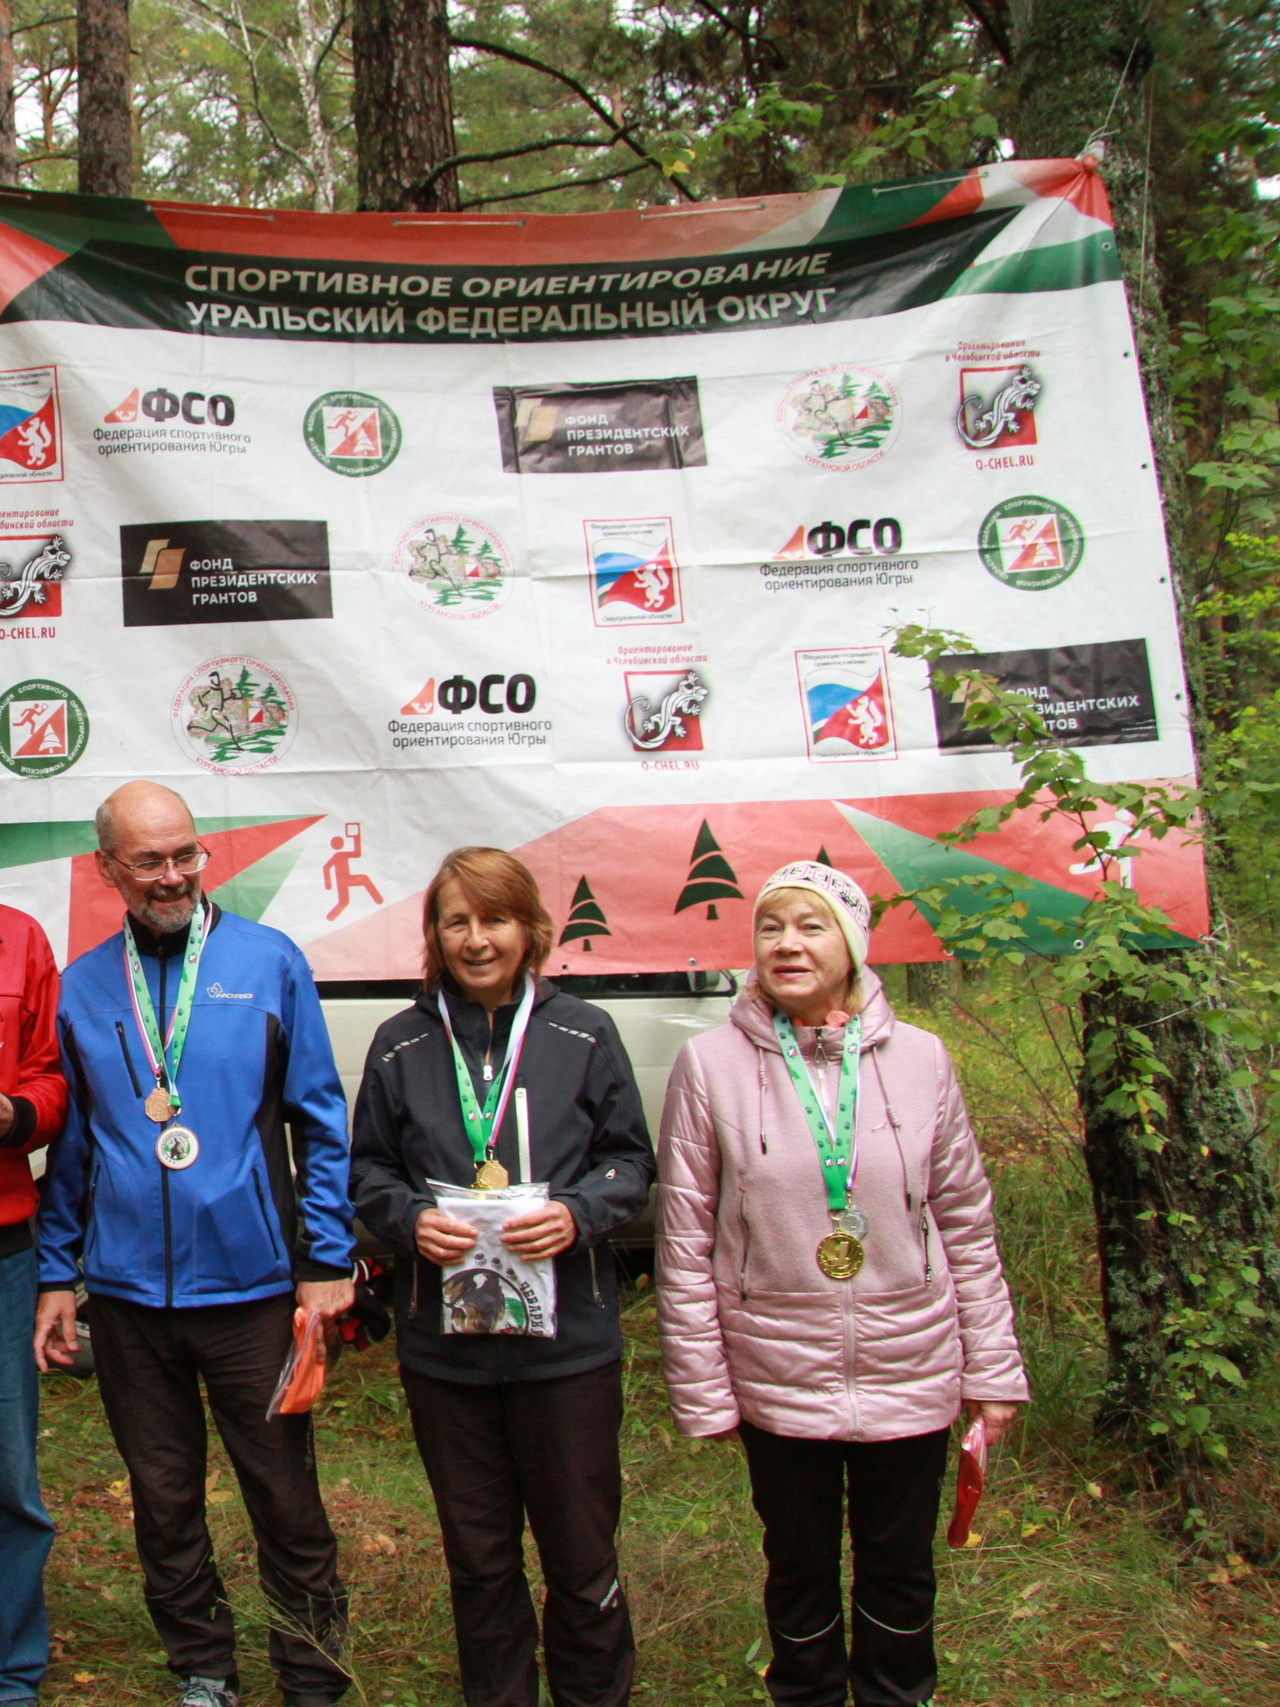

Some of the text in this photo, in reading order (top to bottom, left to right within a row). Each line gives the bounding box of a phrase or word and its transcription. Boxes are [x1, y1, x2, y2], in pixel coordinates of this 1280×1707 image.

[185, 252, 832, 298] СПОРТИВНОЕ ОРИЕНТИРОВАНИЕ
[185, 287, 837, 338] УРАЛЬСКИЙ ФЕДЕРАЛЬНЫЙ ОКРУГ
[142, 387, 236, 426] ФСО
[565, 414, 609, 426] ФОНД
[93, 428, 251, 444] Федерация спортивного
[566, 426, 690, 441] ПРЕЗИДЕНТСКИХ
[98, 442, 246, 457] ориентирования Югры
[568, 444, 634, 457] ГРАНТОВ
[37, 519, 74, 528] области
[806, 517, 902, 557] ФСО
[190, 558, 234, 572] ФОНД
[760, 560, 918, 578] Федерация спортивного
[192, 573, 318, 588] ПРЕЗИДЕНТСКИХ
[765, 573, 913, 593] ориентирования Югры
[192, 592, 258, 606] ГРАНТОВ
[618, 644, 692, 656] Ориентирование
[194, 656, 245, 676] СПОРТИВНОГО
[613, 655, 668, 664] Челябинской
[670, 654, 708, 664] области
[18, 684, 68, 698] СПОРТИВНОГО
[437, 674, 536, 714] ФСО
[1010, 696, 1140, 716] ЗИДЕНТСКИХ
[388, 720, 552, 734] Федерация спортивного
[392, 732, 546, 750] ориентирования Югры
[21, 762, 65, 774] ТЮМЕНСКОЙ
[196, 755, 278, 776] КУРГАНСКОЙ ОБЛАСТИ
